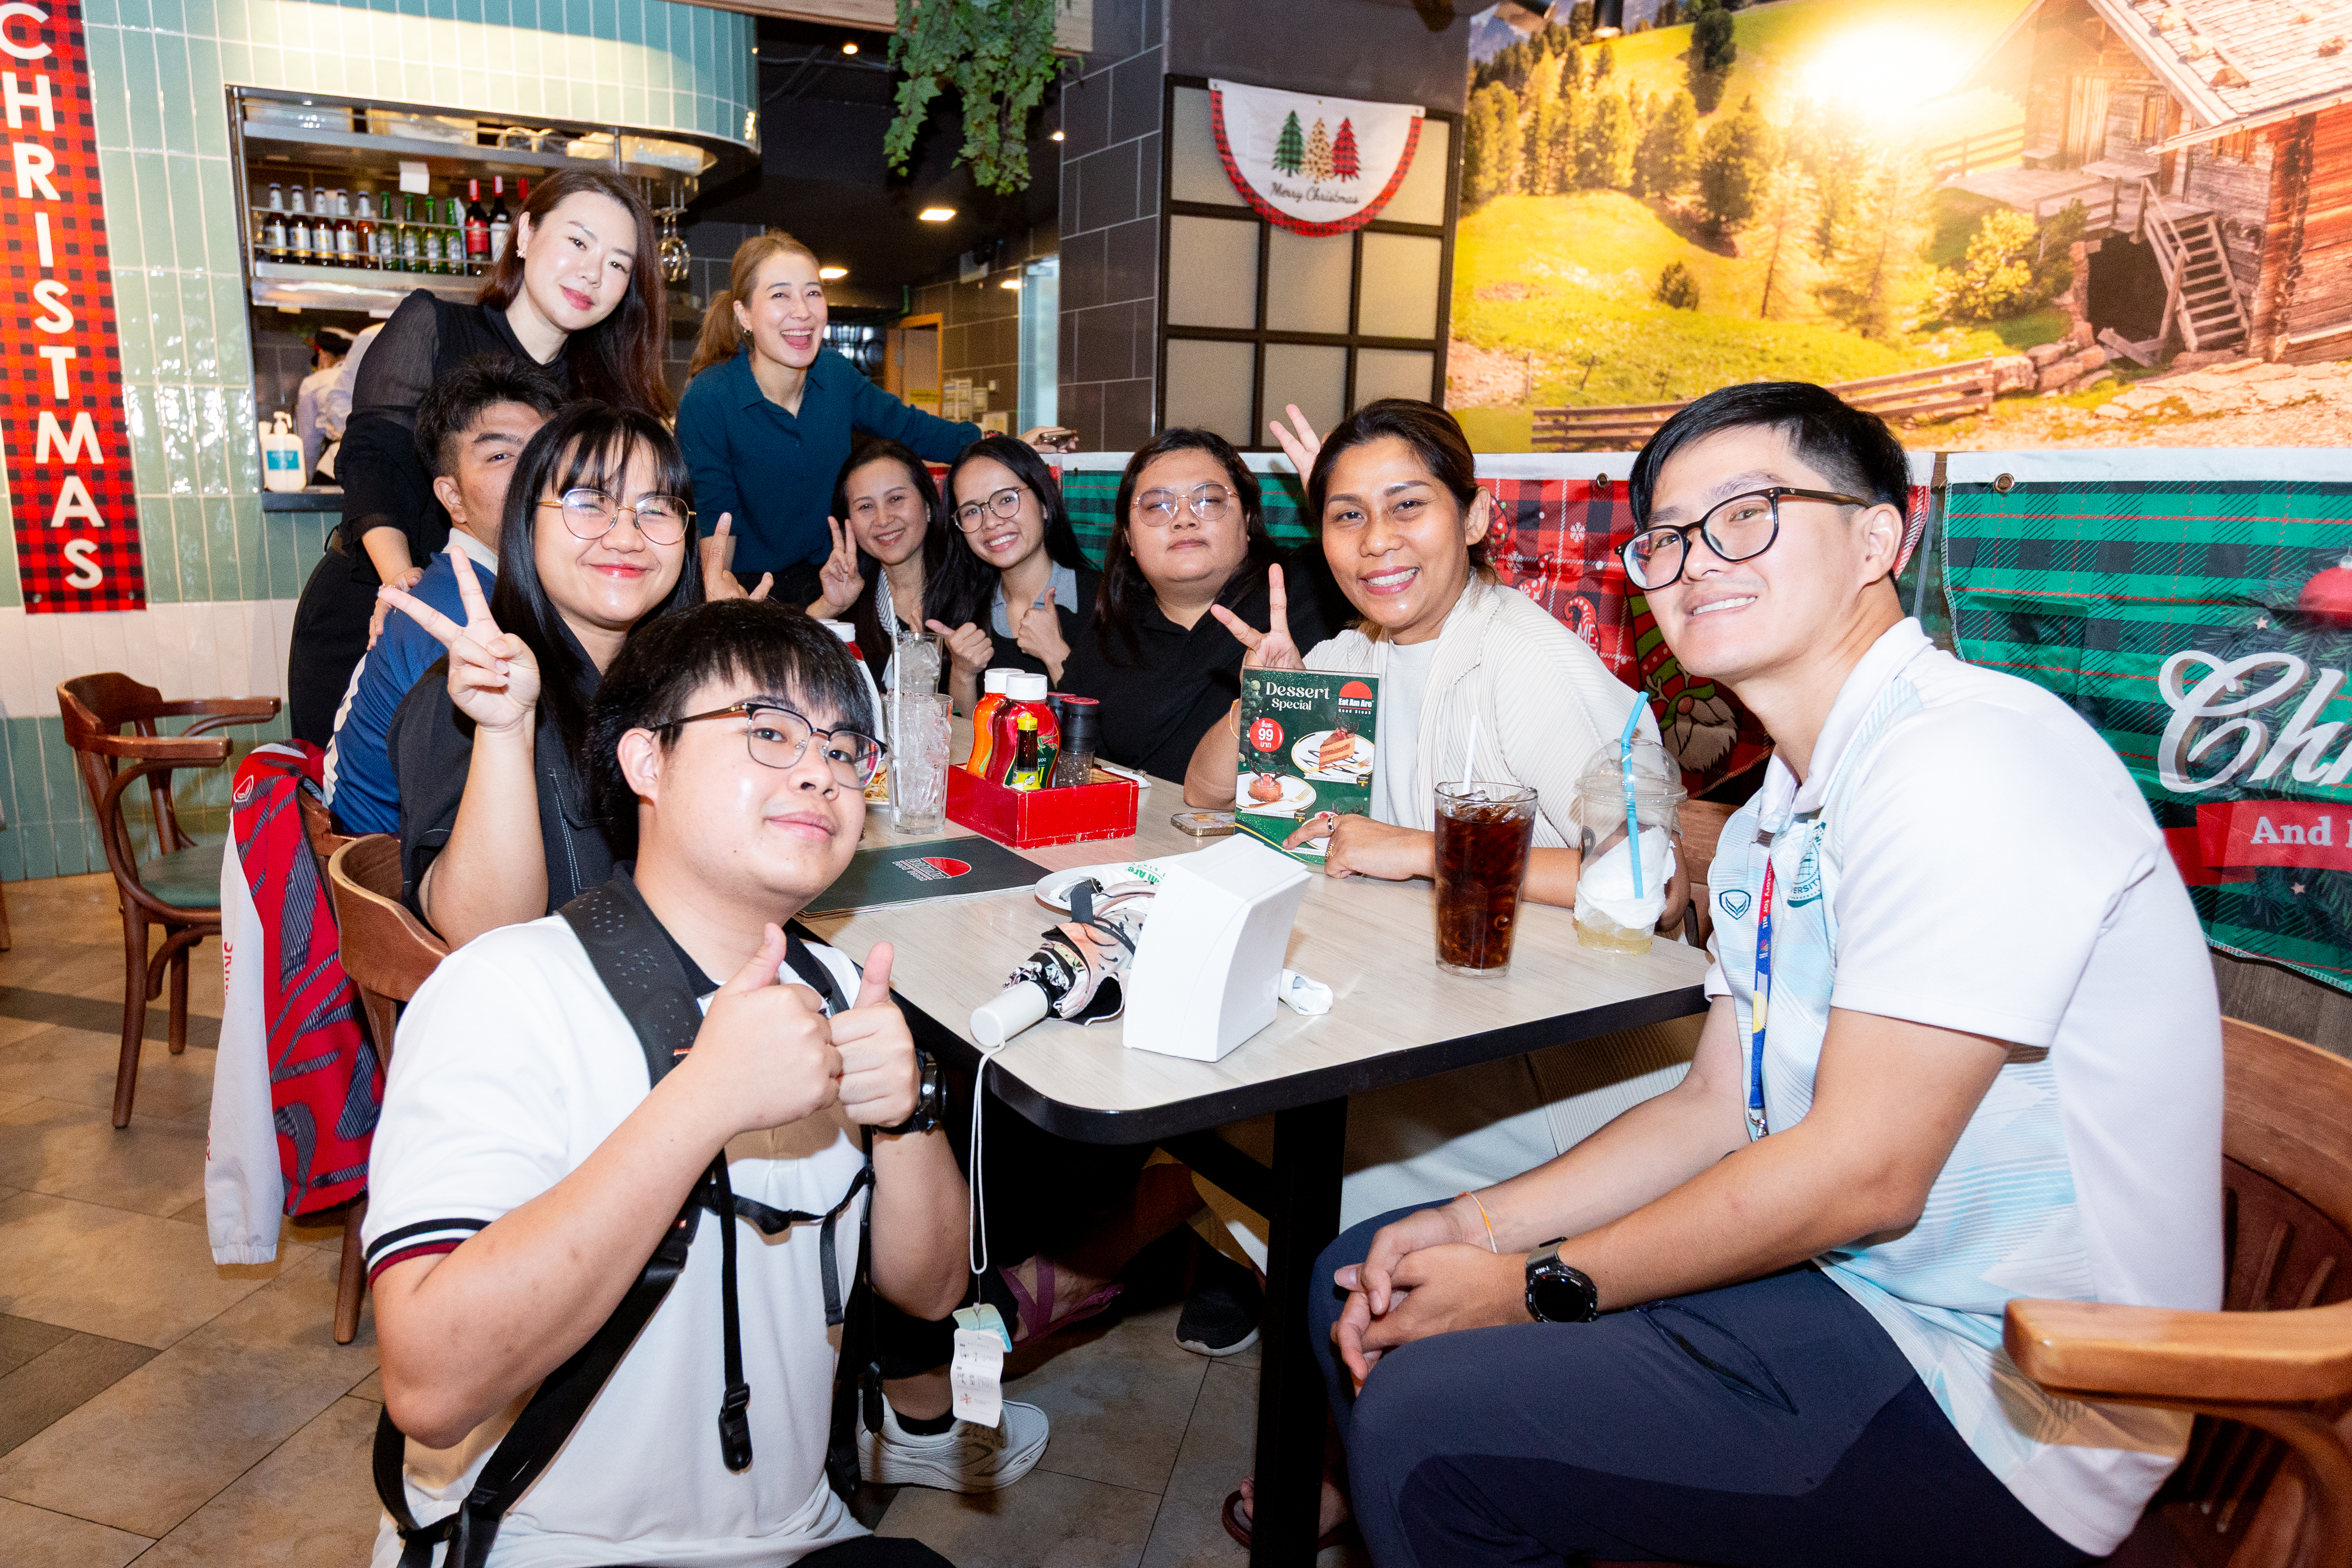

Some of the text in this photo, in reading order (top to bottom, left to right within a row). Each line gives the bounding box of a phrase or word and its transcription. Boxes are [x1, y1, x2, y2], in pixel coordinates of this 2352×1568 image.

[1271, 182, 1358, 204] Merry Christmas
[0, 2, 105, 589] CHRISTMAS
[1266, 682, 1330, 700] Dessert
[1272, 698, 1311, 711] Special
[1258, 728, 1273, 741] 99
[2251, 816, 2332, 846] And
